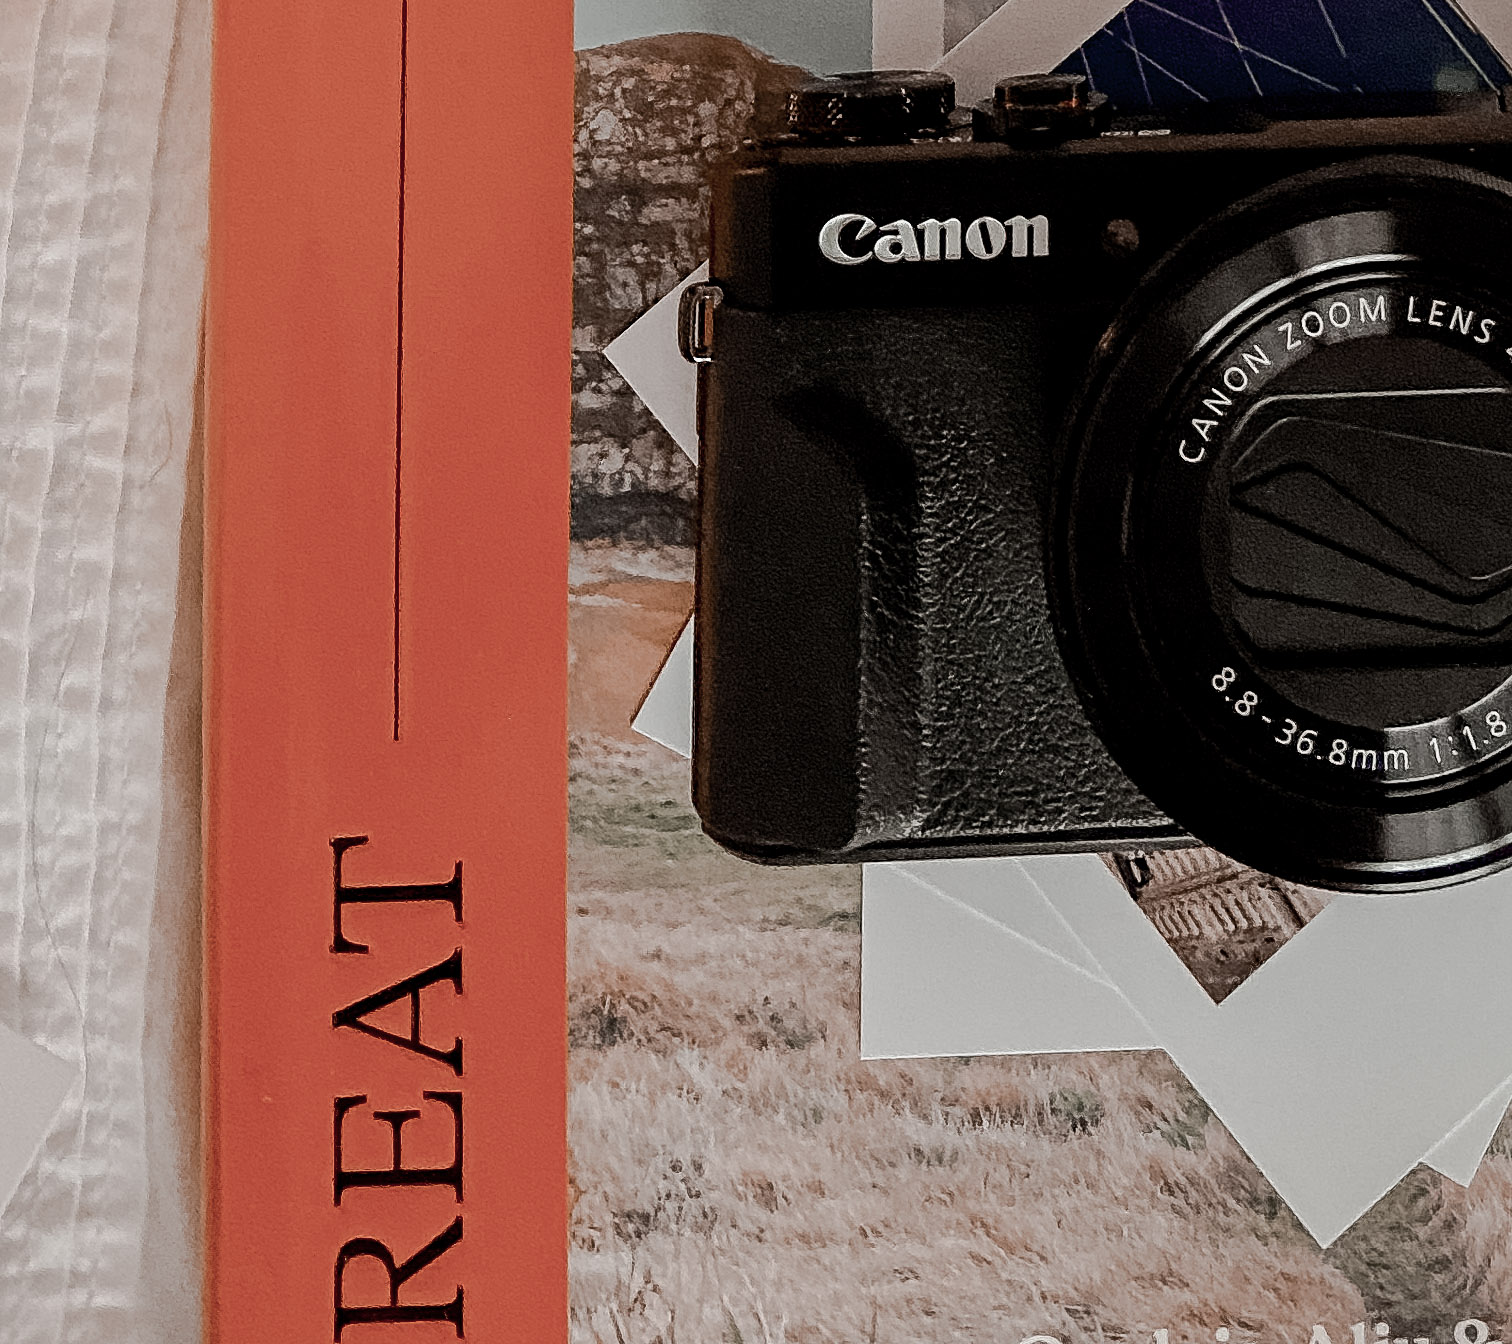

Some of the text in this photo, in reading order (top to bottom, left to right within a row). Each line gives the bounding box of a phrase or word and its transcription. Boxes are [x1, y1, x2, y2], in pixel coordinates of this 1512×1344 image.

[818, 213, 1050, 265] Canon
[1178, 344, 1272, 464] CANON
[1278, 295, 1388, 352] ZOOM
[1407, 296, 1497, 344] LENS
[328, 834, 466, 1344] REAT
